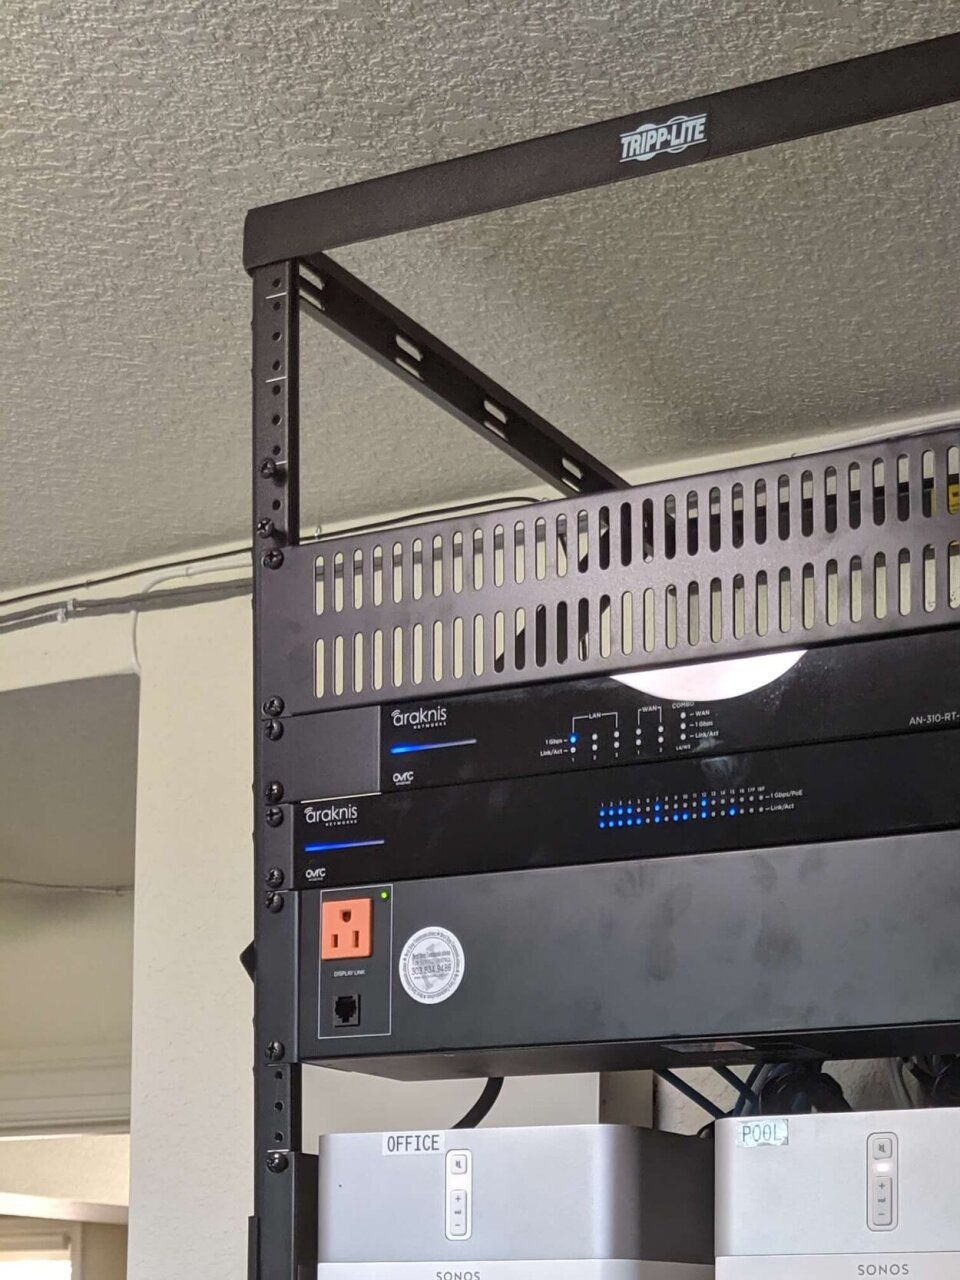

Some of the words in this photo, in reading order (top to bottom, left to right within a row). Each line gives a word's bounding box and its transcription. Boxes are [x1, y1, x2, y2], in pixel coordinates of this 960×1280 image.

[392, 706, 447, 726] araknis
[305, 804, 358, 824] araknis
[770, 803, 795, 811] Link/Act
[741, 1124, 782, 1142] POOL
[387, 1134, 440, 1152] OFFICE
[857, 1263, 910, 1276] SONOS
